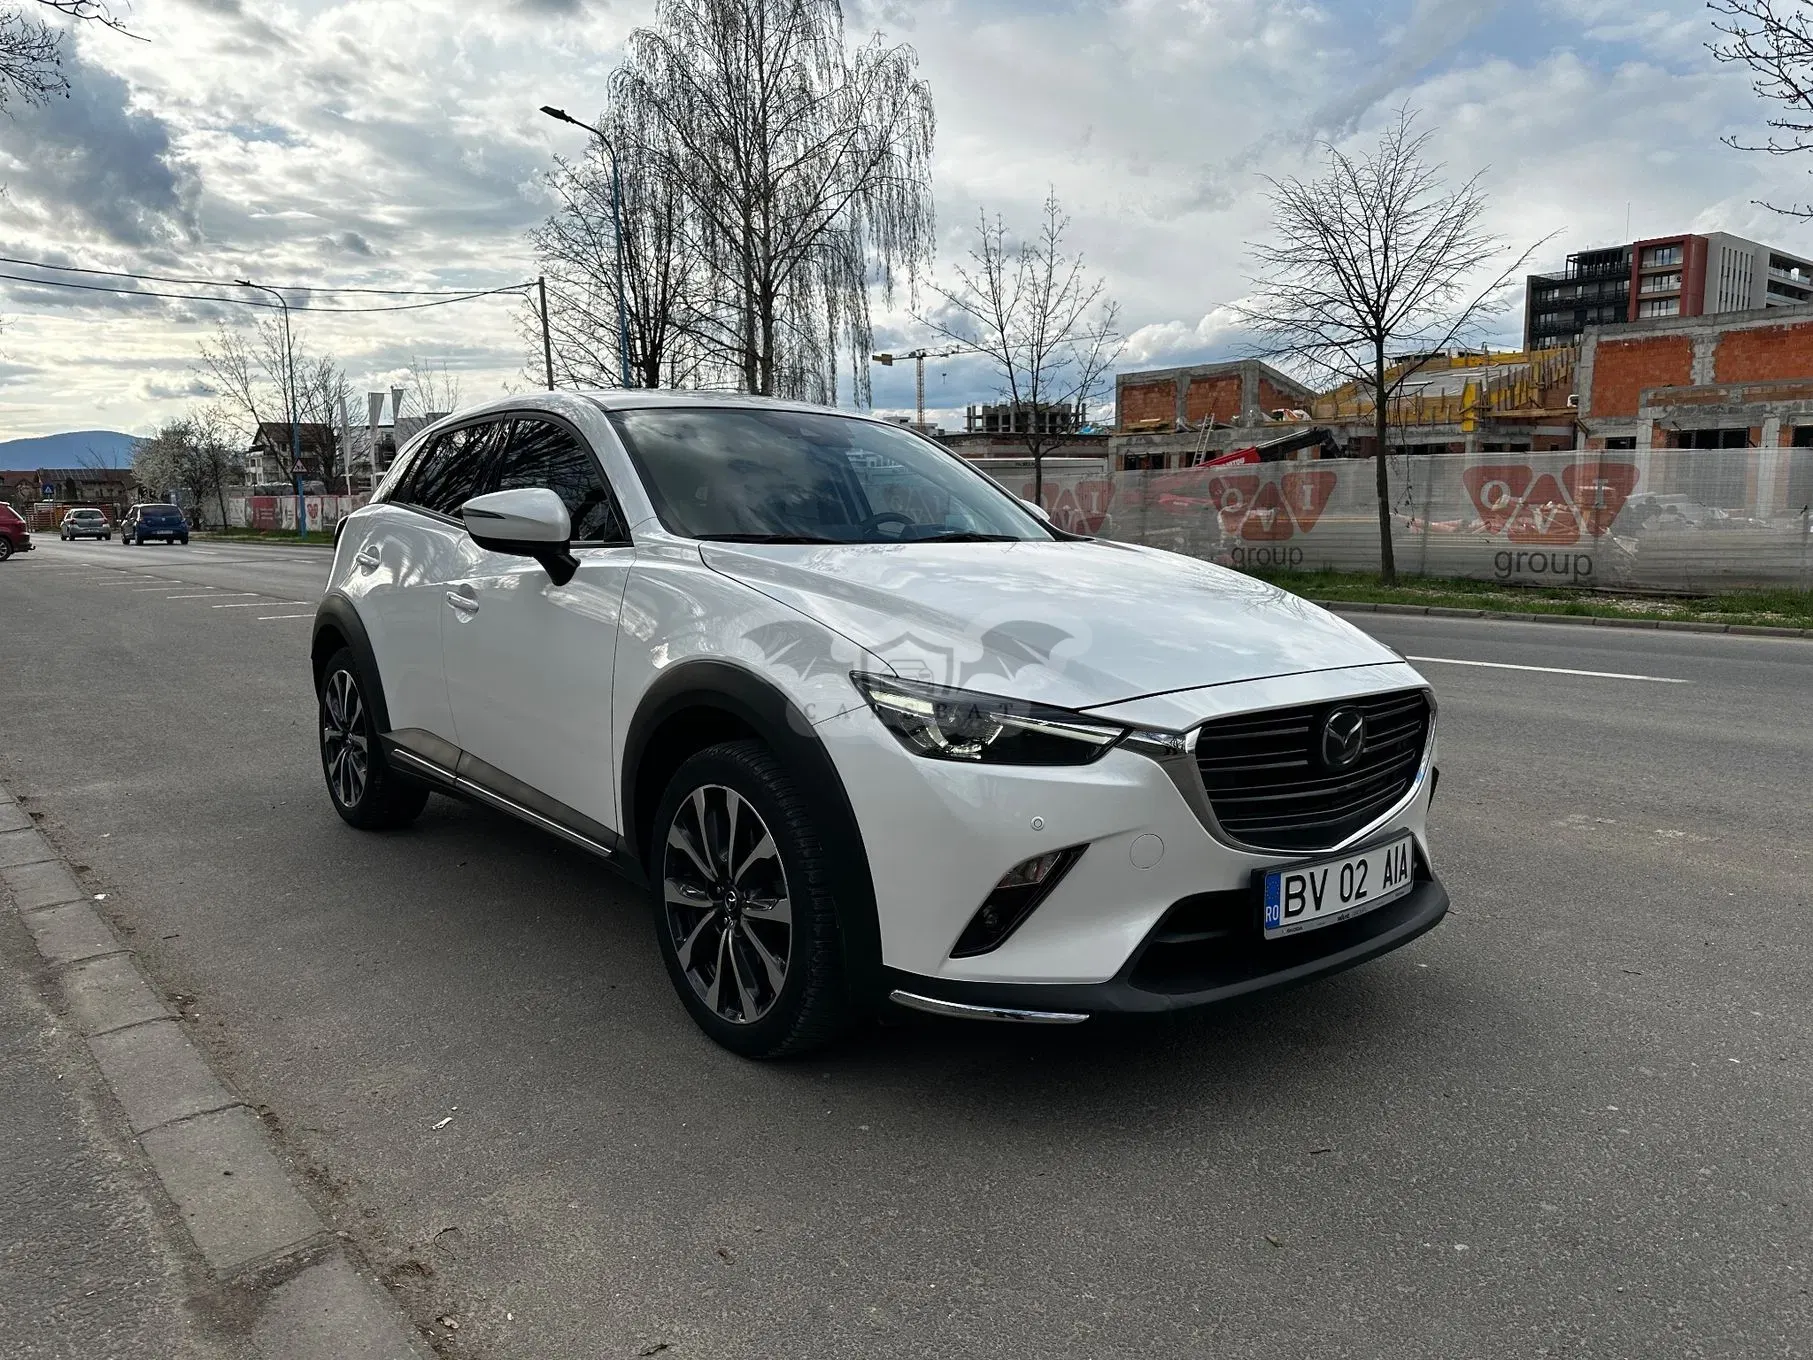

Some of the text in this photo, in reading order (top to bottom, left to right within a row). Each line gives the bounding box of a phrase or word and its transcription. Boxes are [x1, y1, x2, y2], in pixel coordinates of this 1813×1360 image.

[1231, 546, 1304, 570] group
[1494, 549, 1594, 583] group
[1284, 843, 1408, 917] BV 02 AIA
[1266, 905, 1279, 922] RO
